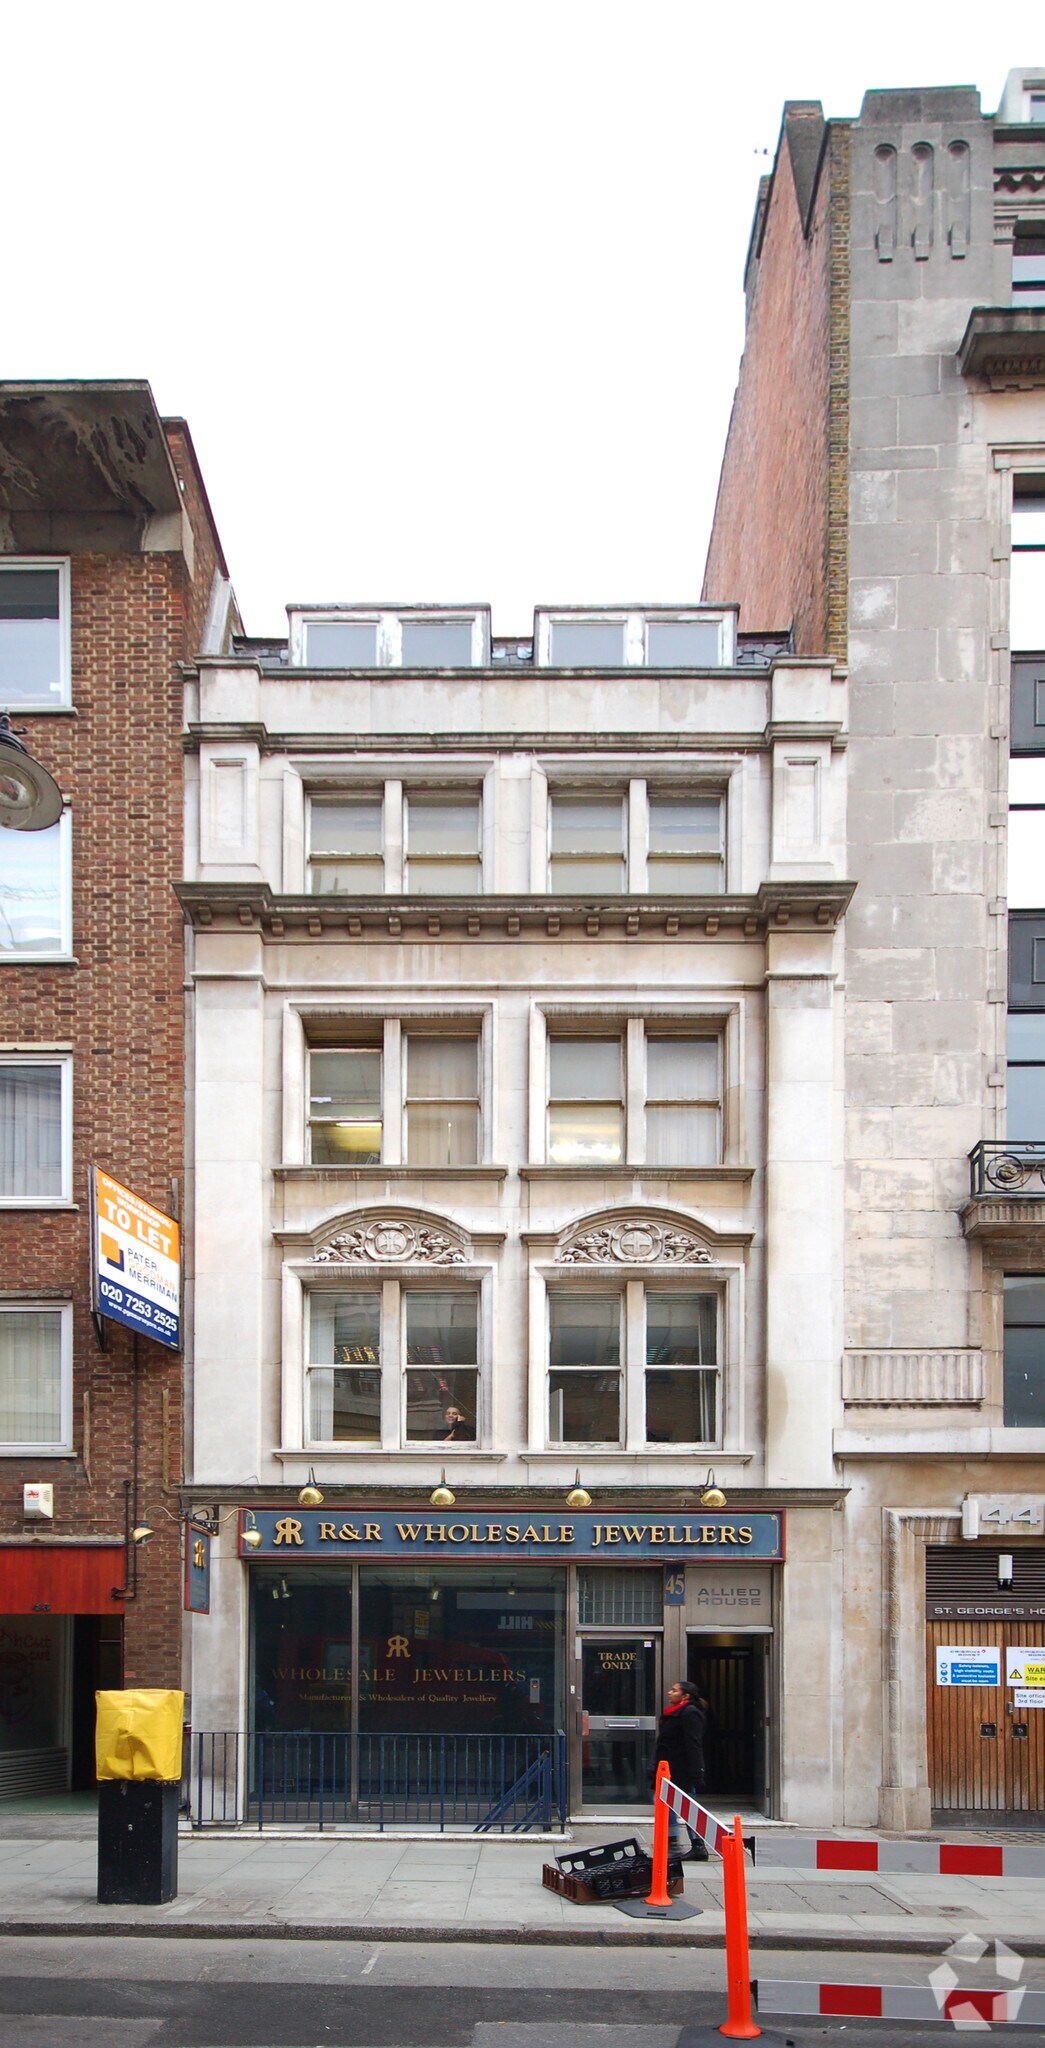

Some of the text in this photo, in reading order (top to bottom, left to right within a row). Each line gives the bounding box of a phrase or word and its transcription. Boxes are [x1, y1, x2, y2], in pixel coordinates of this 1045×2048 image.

[104, 1198, 172, 1255] TO LET
[127, 1247, 158, 1272] PATER
[128, 1258, 176, 1292] GOODMAN
[128, 1267, 178, 1303] MERRIMAN
[101, 1281, 178, 1332] 020 7253 2525
[981, 1504, 1041, 1526] 44
[318, 1522, 384, 1542] R&R
[396, 1523, 576, 1544] WHOLESALE
[591, 1524, 754, 1548] JEWELLERS
[665, 1573, 685, 1596] 45
[697, 1588, 762, 1596] ALLIED
[697, 1597, 762, 1606] HOUSE
[934, 1607, 953, 1615] ST.
[957, 1607, 1025, 1615] GEORGE'S
[598, 1652, 637, 1661] TRADE
[602, 1662, 633, 1670] ONLY
[271, 1667, 527, 1684] WHOLESALE JEWELLERS
[298, 1693, 497, 1703] Manufacturer & Wholesalers of Quality Jewellery
